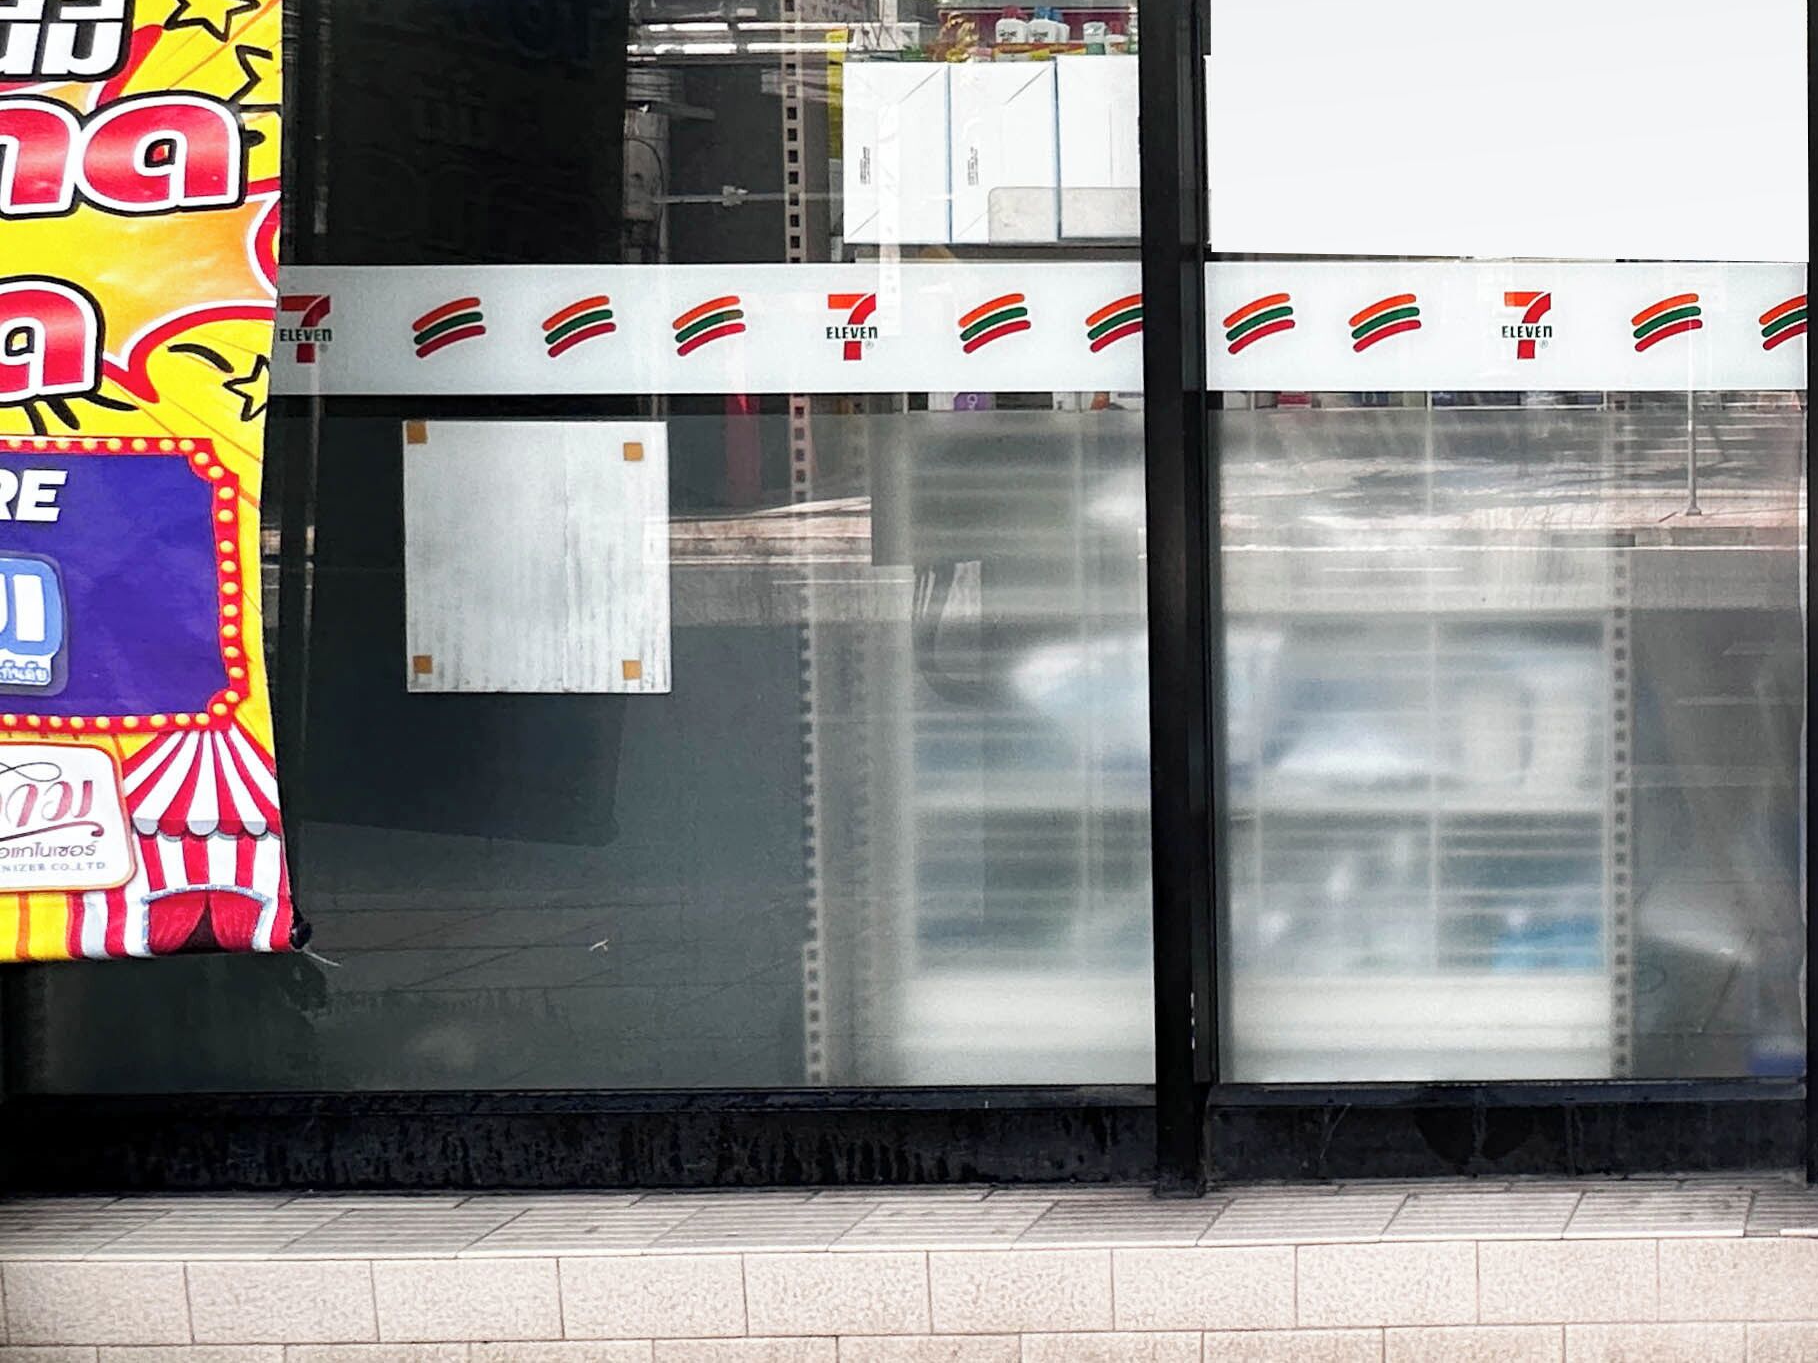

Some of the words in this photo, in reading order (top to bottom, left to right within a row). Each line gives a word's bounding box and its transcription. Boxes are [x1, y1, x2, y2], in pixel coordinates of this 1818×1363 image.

[281, 295, 330, 363] 7
[828, 293, 876, 360] 7
[1504, 292, 1551, 359] 7
